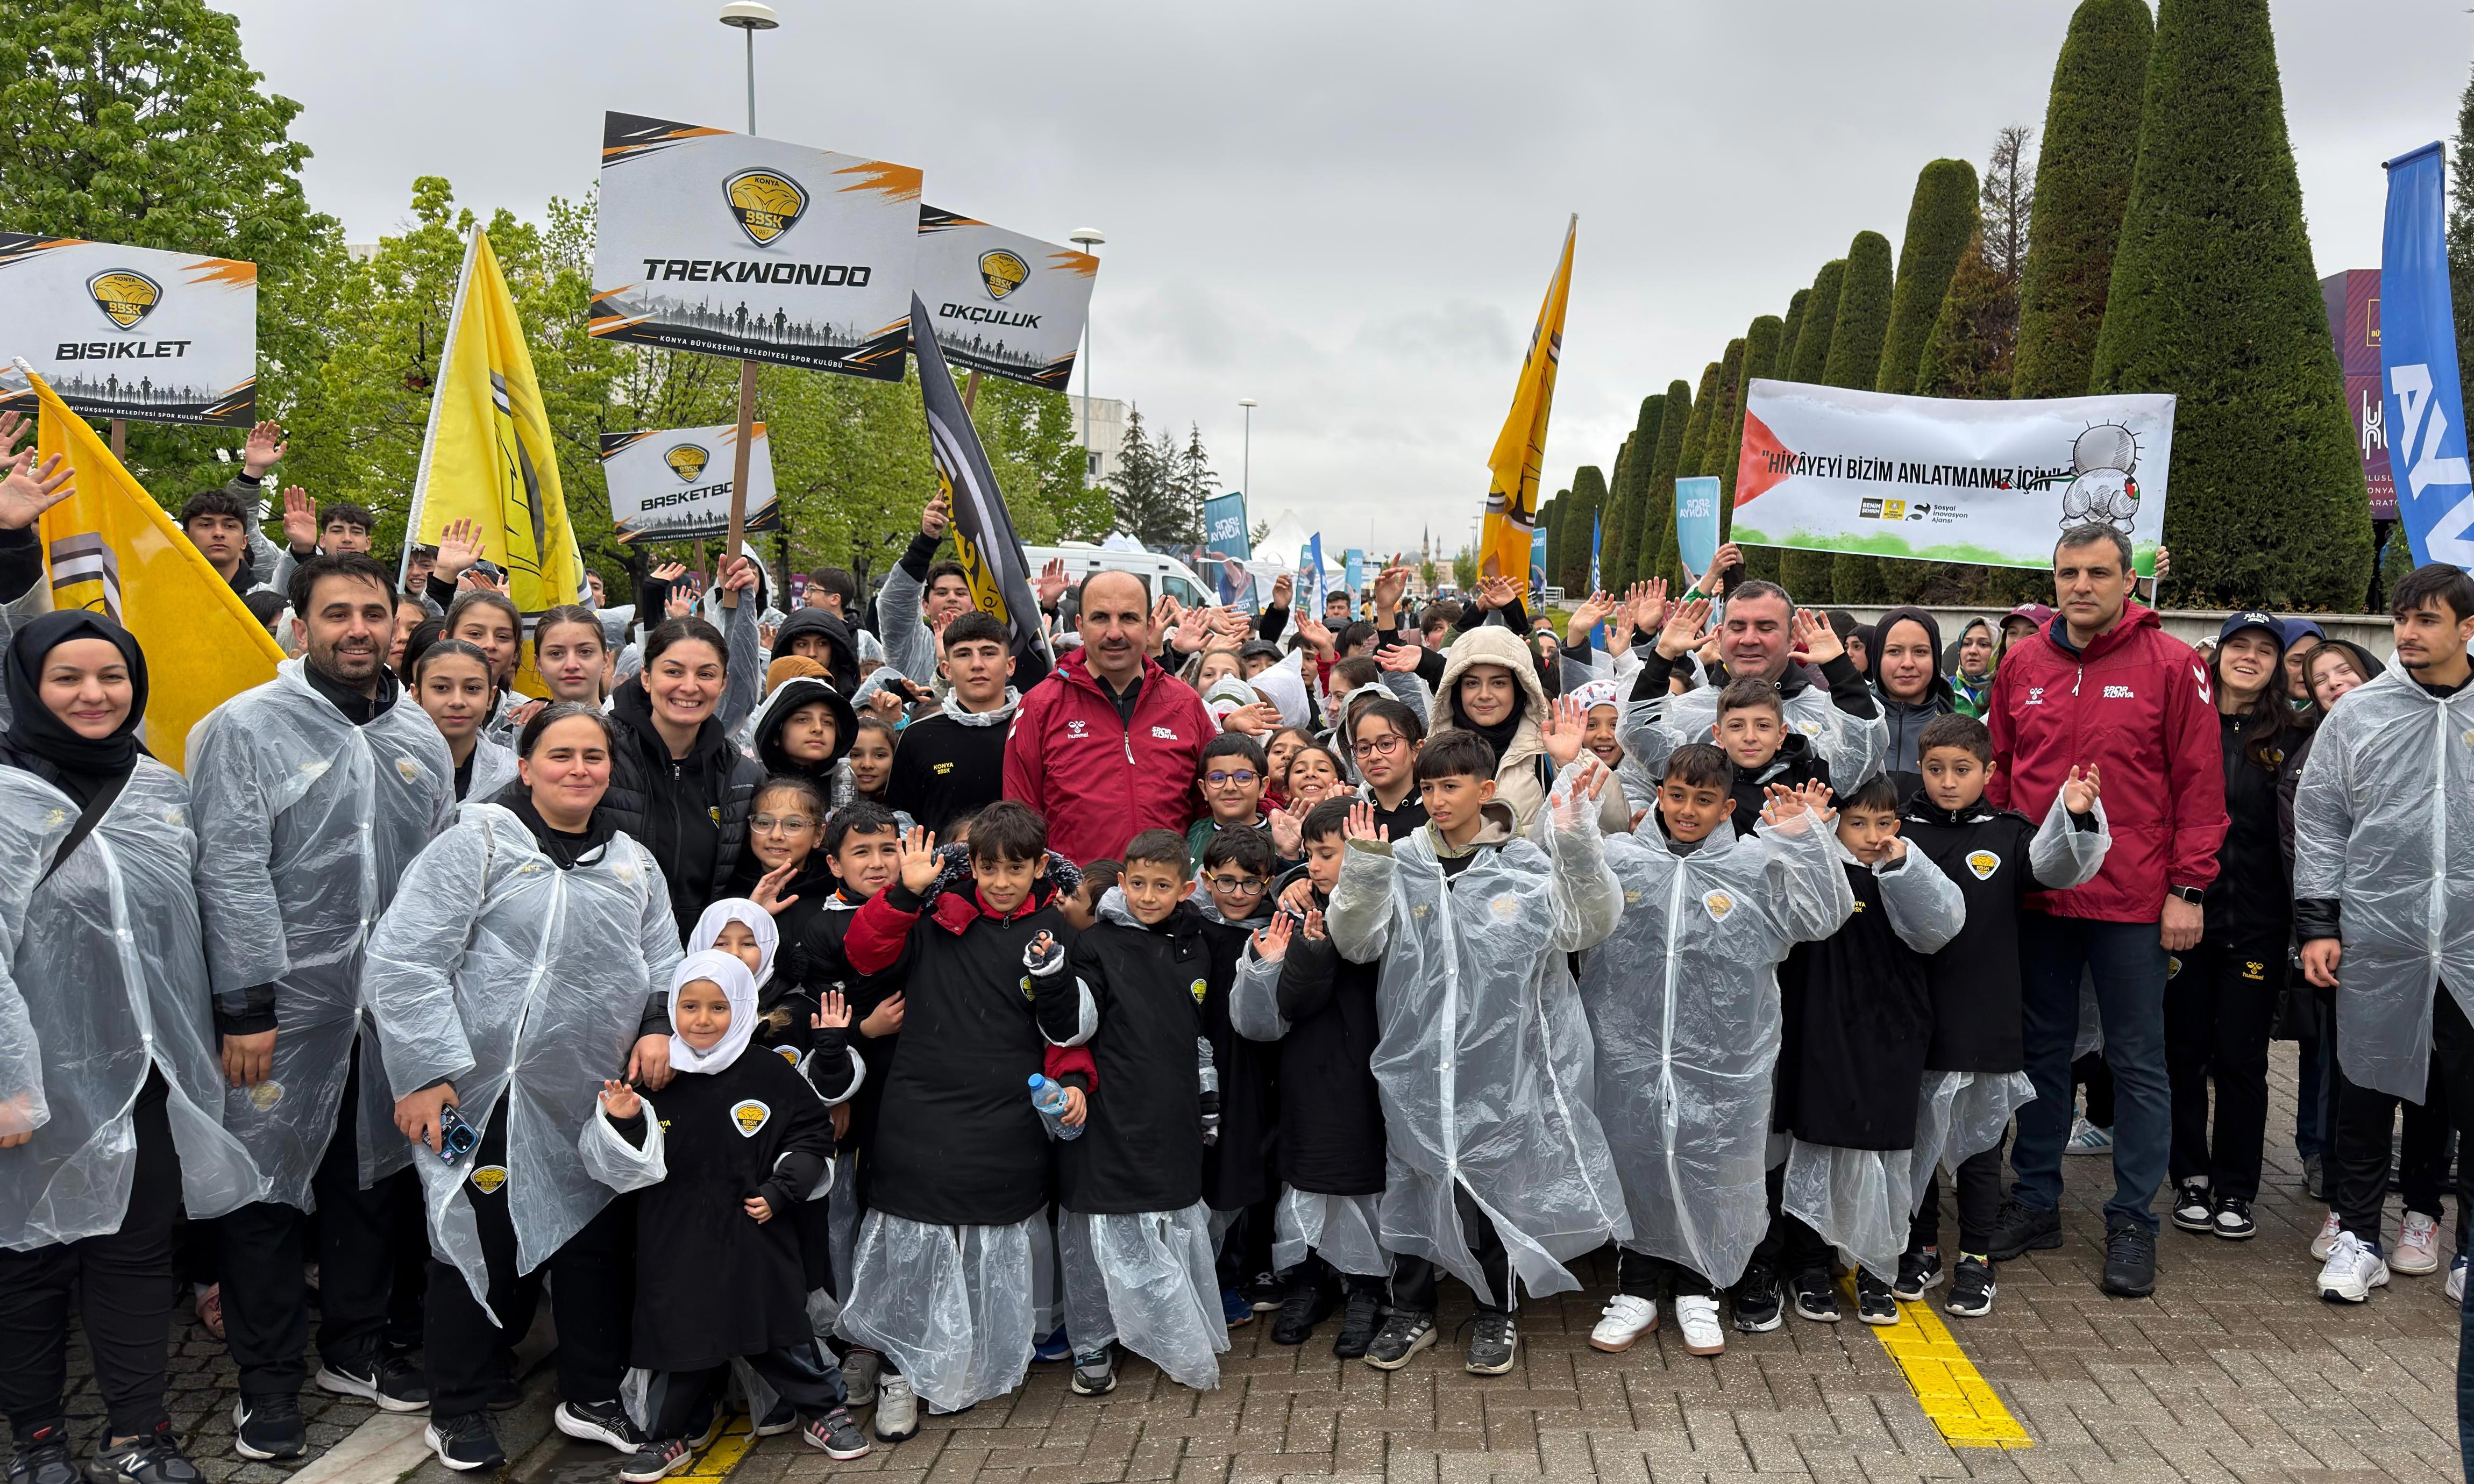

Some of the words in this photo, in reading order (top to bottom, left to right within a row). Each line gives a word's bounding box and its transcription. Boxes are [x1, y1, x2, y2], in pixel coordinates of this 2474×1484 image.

[755, 177, 780, 187] KONYA
[745, 210, 783, 229] BBSK
[998, 254, 1014, 263] KONYA
[643, 259, 872, 287] TAEKWONDO
[109, 302, 142, 315] BBSK
[939, 303, 1043, 329] OKÇULUK
[659, 335, 687, 345] KONYA
[691, 339, 741, 353] BÜYÜKŞEHİR
[744, 347, 788, 360] BELEDİYESİ
[791, 354, 811, 363] SPOR
[813, 358, 843, 368] KULÜBÜ
[70, 405, 114, 414] BÜYÜKŞEHİR
[117, 409, 155, 417] BELEDİYESİ
[1761, 450, 1843, 478] "HİKÂYEYİ
[1846, 455, 1893, 482] BİZİM
[1897, 462, 2014, 490] ANLATMAMIZ
[641, 481, 733, 511] BASKETBO
[1932, 510, 1968, 519] İnovasyon
[2243, 612, 2270, 622] PARIS
[2103, 690, 2134, 698] KONYA
[1151, 726, 1172, 734] SPOR
[1152, 731, 1178, 740] KONYA
[933, 762, 954, 770] KONYA
[2242, 971, 2264, 980] hummel
